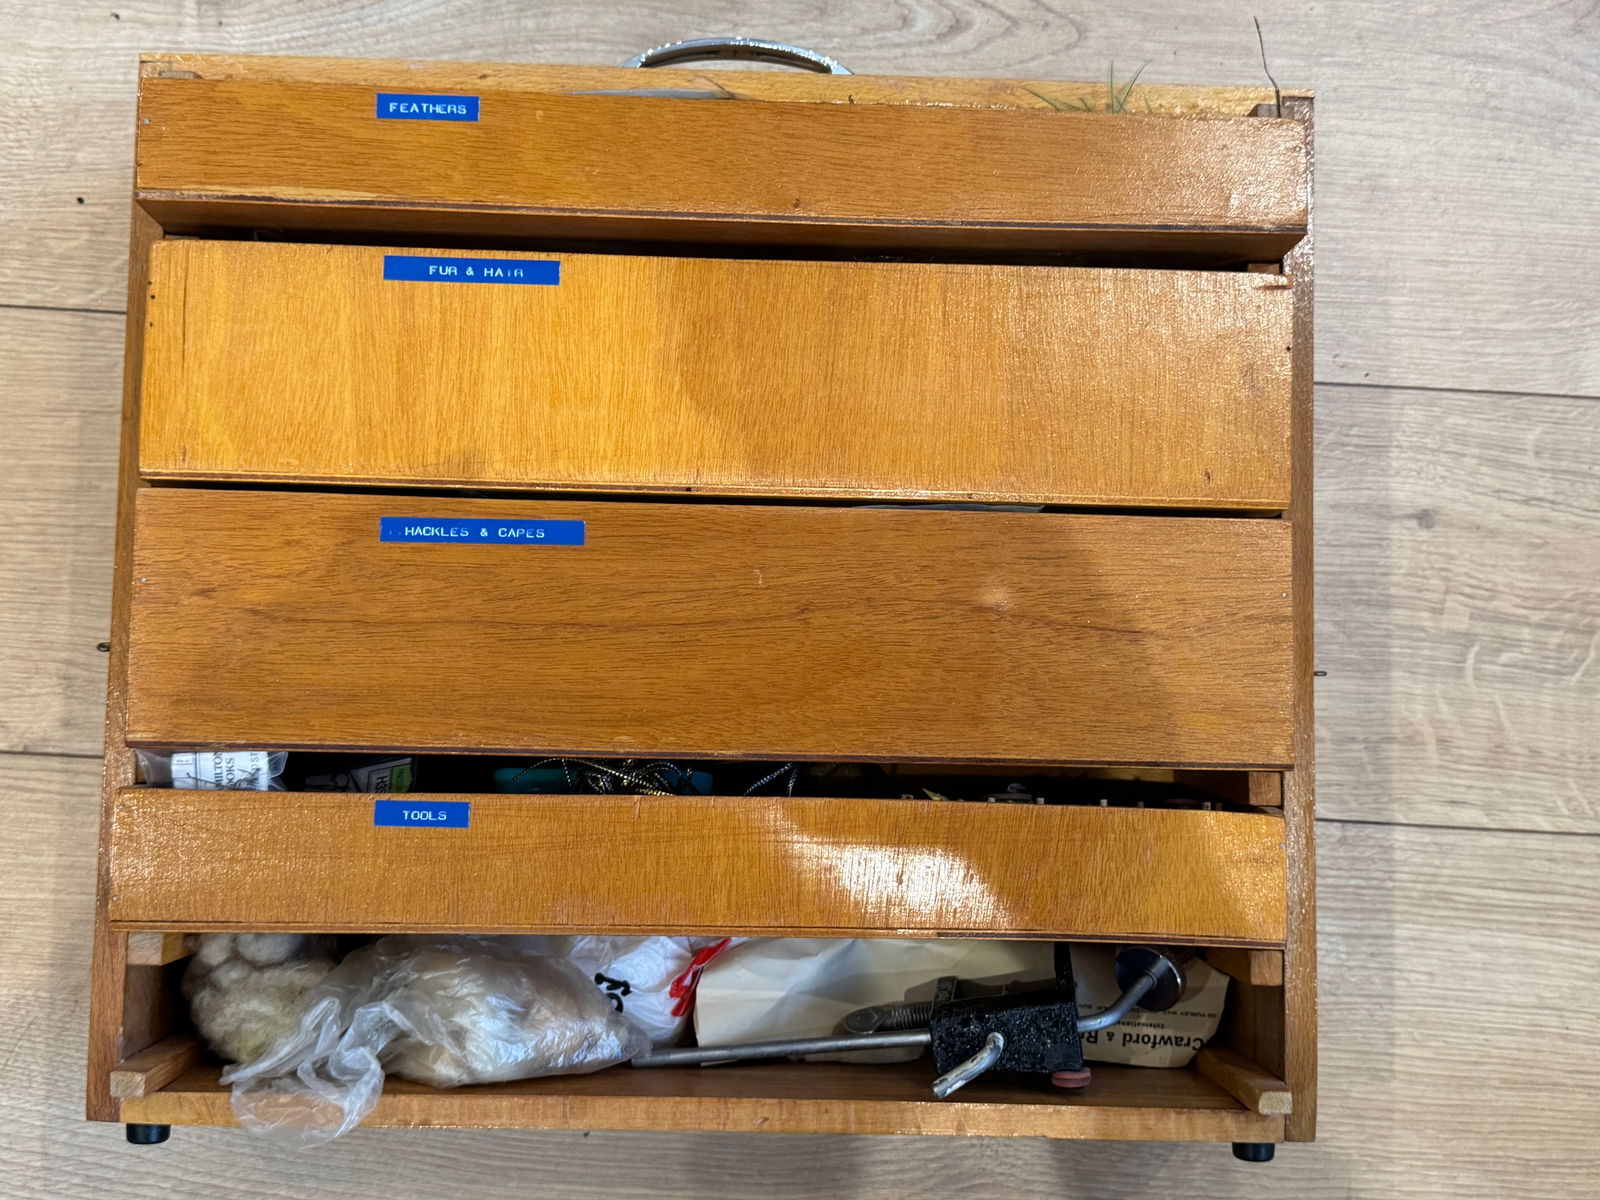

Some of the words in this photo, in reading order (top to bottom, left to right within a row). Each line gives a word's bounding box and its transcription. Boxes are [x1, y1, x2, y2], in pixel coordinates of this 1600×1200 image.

[389, 102, 467, 115] FEATHERS
[429, 265, 458, 276] FUR
[465, 266, 474, 276] &
[483, 267, 524, 278] HAIR
[404, 526, 469, 537] HACKLES
[479, 527, 489, 537] &
[498, 527, 545, 539] CAPES
[402, 810, 447, 821] TOOLS
[1106, 1030, 1115, 1040] &
[1122, 1031, 1205, 1052] Crawford
